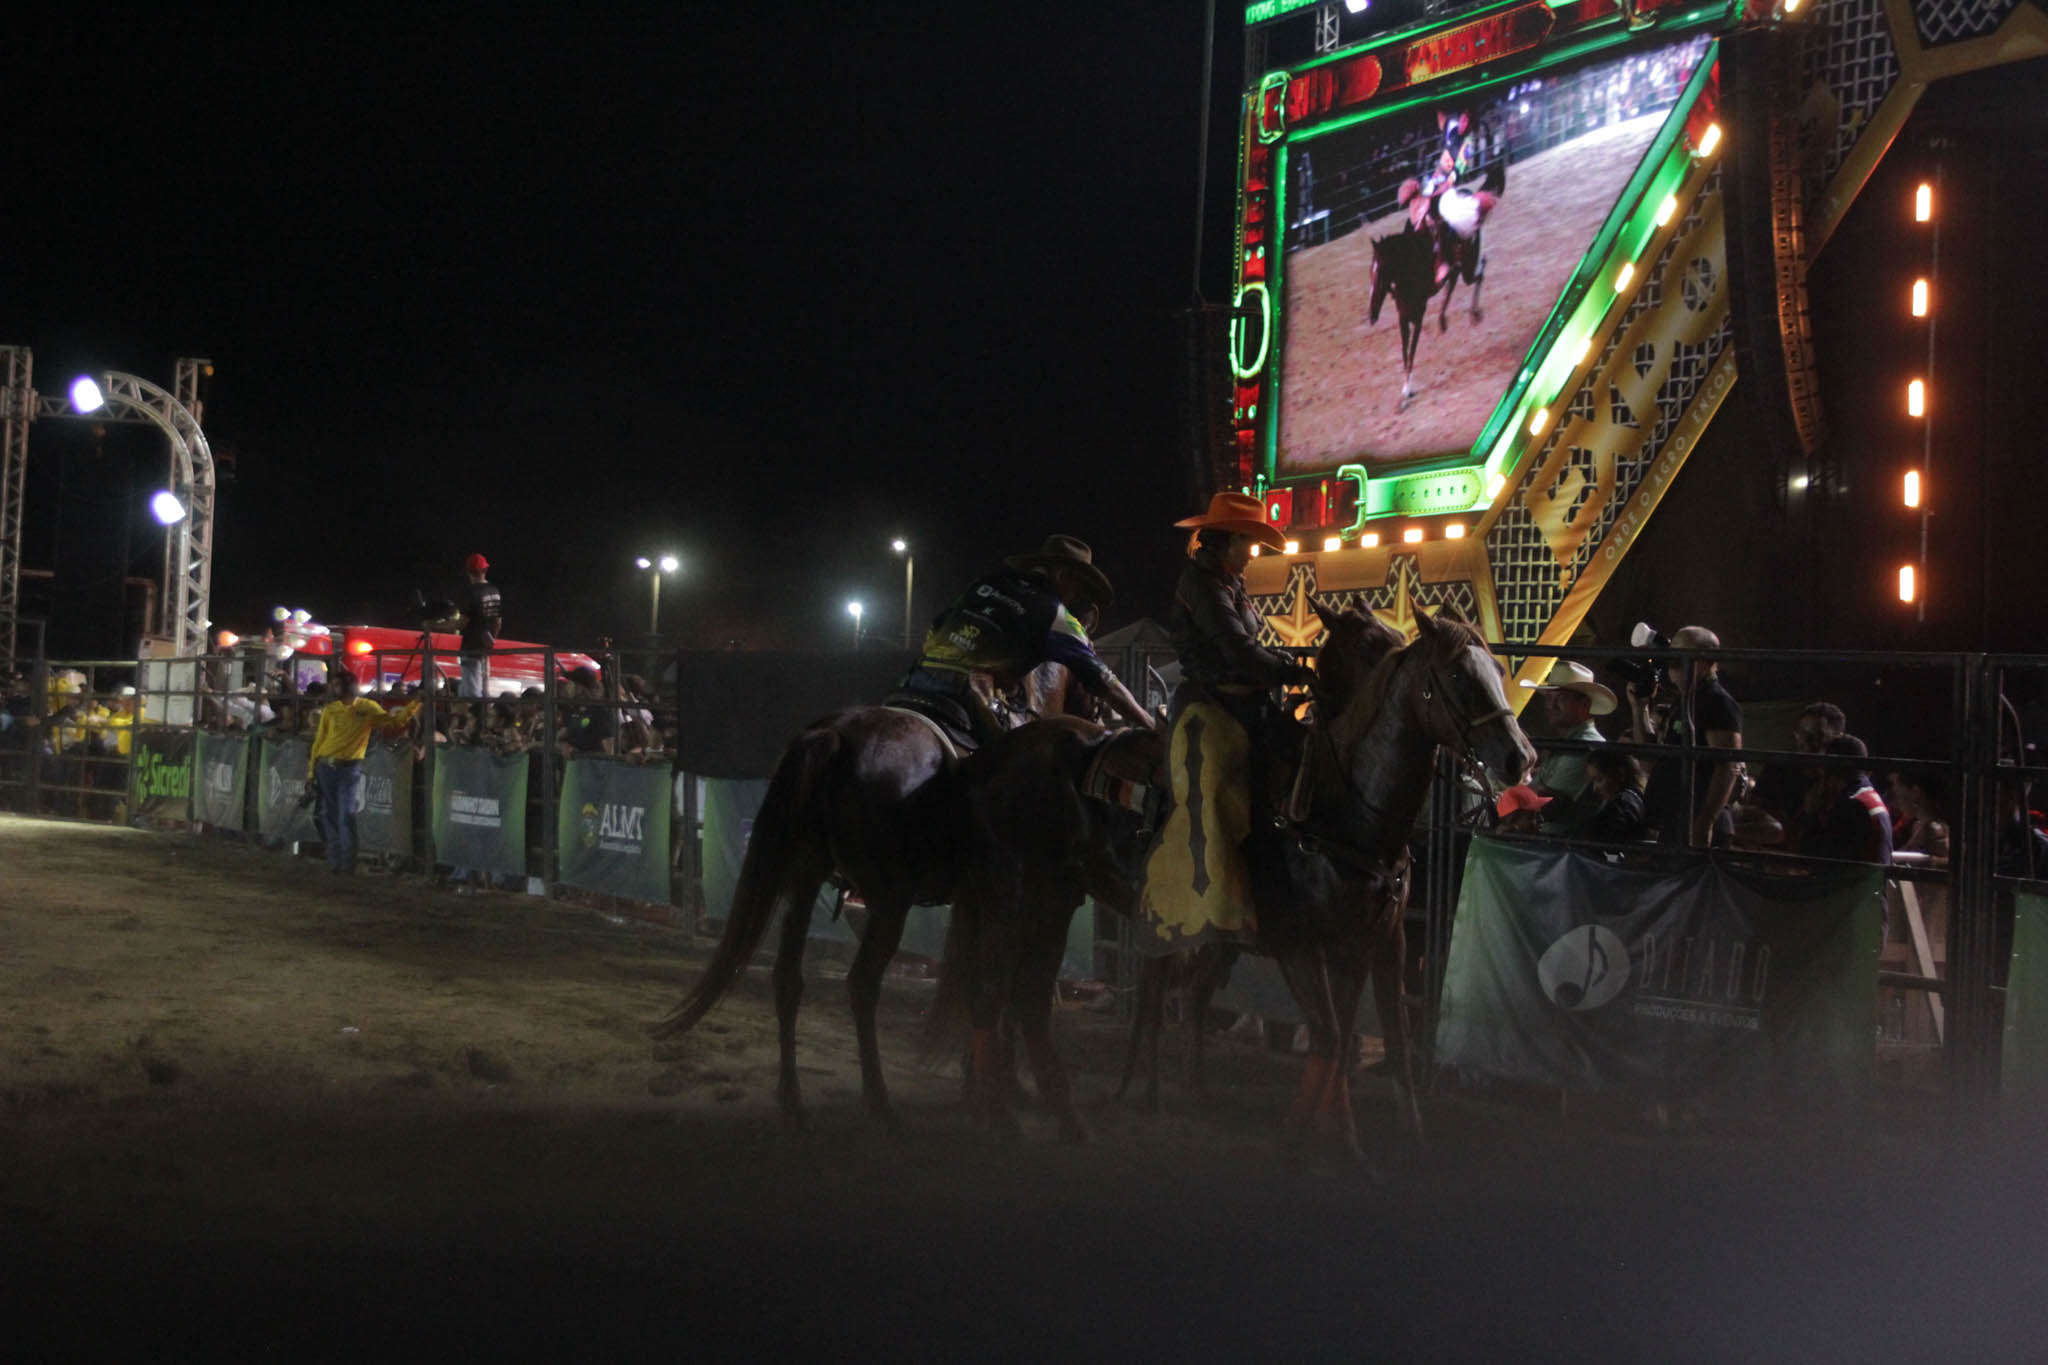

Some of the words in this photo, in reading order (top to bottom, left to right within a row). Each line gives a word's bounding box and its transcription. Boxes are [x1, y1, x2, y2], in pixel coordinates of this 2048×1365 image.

[1605, 511, 1639, 560] ONDE
[1640, 492, 1651, 506] O
[1692, 352, 1735, 424] ENCON
[599, 803, 645, 840] ALMT
[1639, 932, 1771, 1001] DITADO
